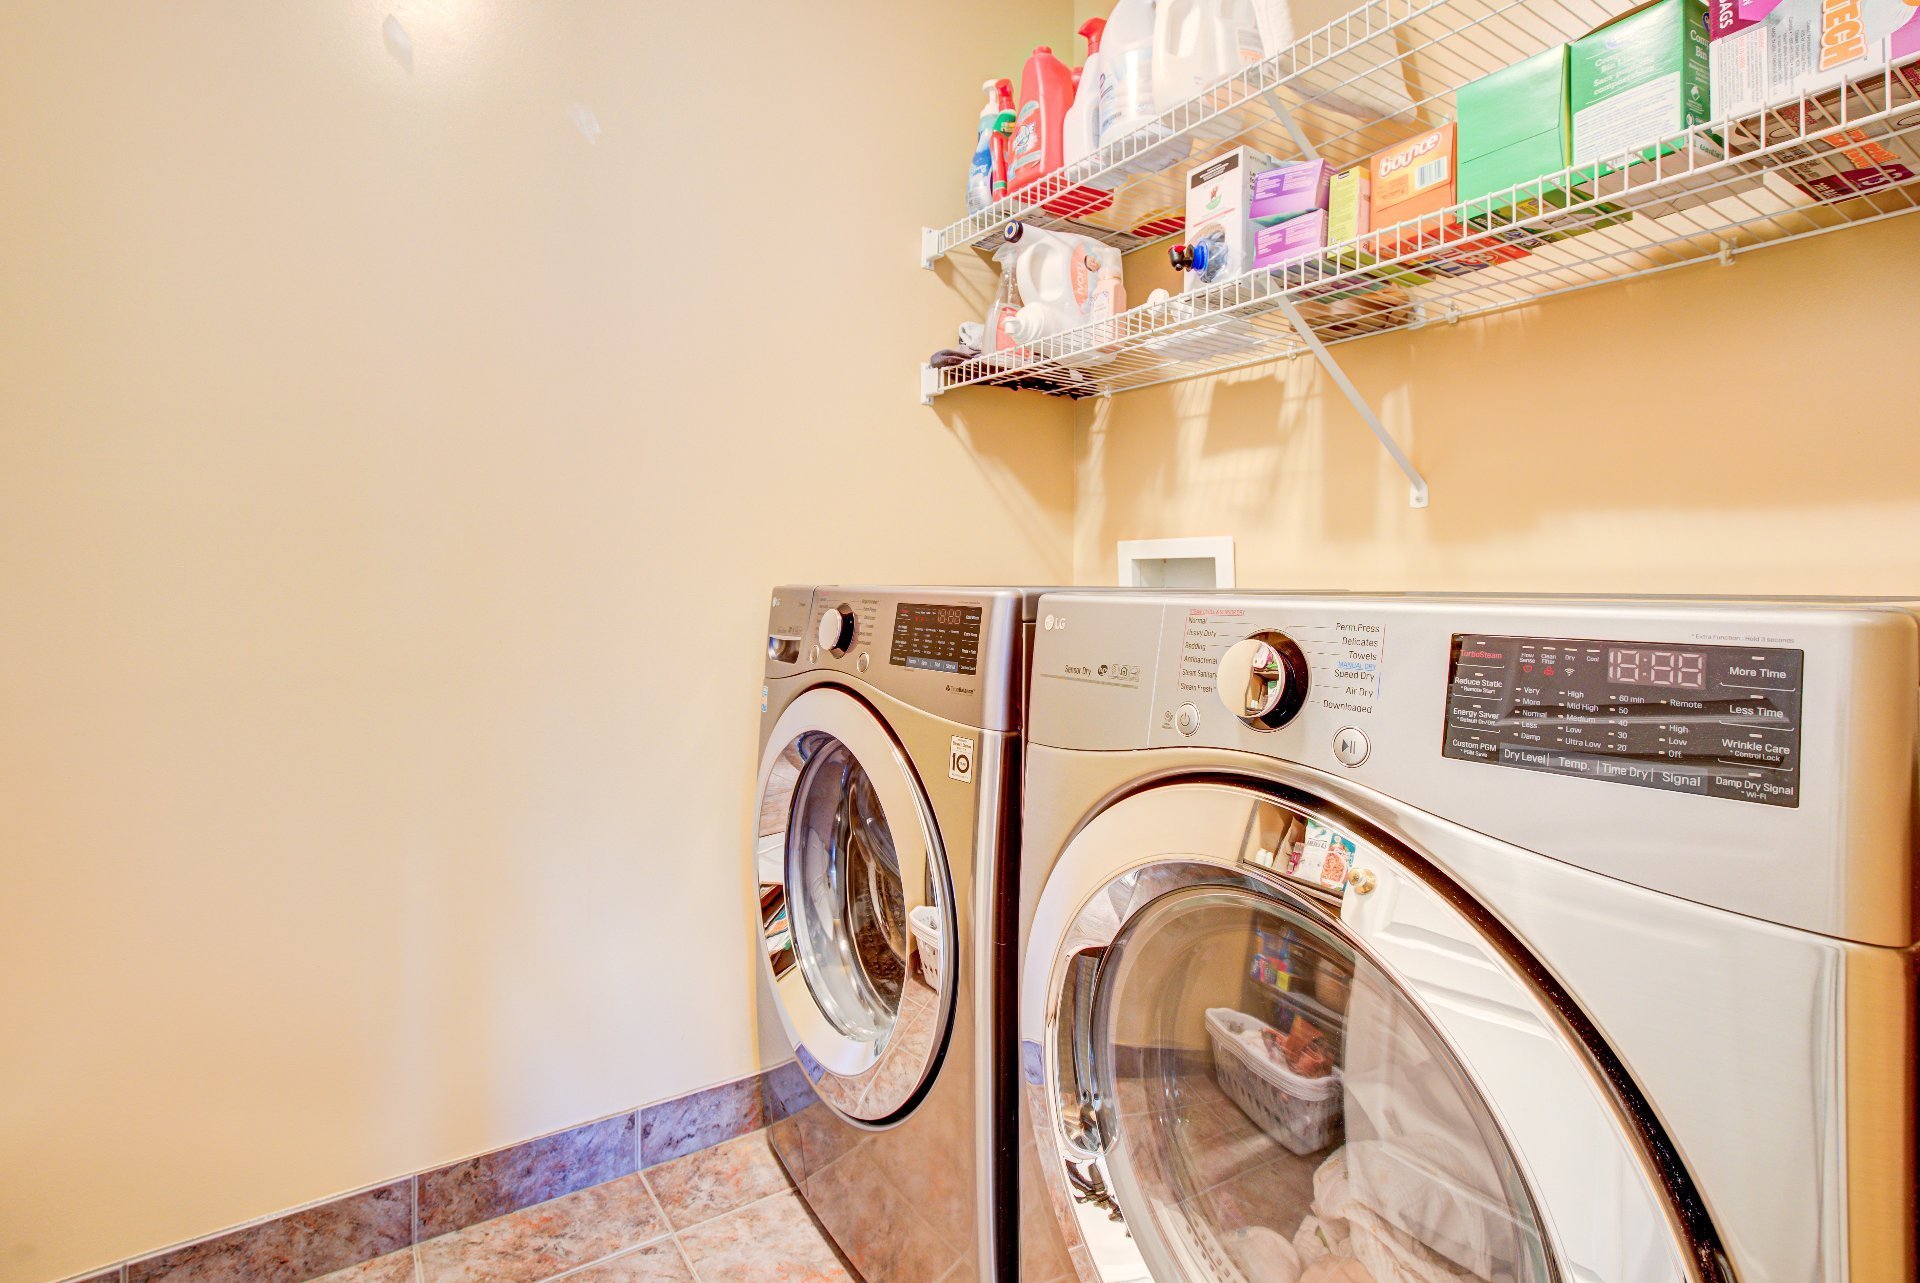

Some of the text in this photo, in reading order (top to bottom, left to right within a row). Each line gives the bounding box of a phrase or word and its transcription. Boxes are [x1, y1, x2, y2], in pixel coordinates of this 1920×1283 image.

[1719, 0, 1733, 29] AGS
[1342, 636, 1379, 647] Delicates
[1349, 650, 1377, 661] Towels
[1460, 649, 1503, 659] TurboSteam
[1334, 668, 1375, 682] Speed Dry
[1729, 666, 1787, 679] More Time
[1454, 676, 1503, 688] Reduce Static
[1345, 686, 1374, 698] Air Dry
[1524, 686, 1540, 695] Very
[1567, 690, 1584, 699] High
[1522, 698, 1541, 706] More
[1630, 696, 1645, 704] min
[1670, 699, 1703, 709] Remote
[1323, 699, 1373, 714] Downloaded
[1566, 702, 1599, 712] Mid High
[1618, 707, 1629, 715] 50
[1729, 704, 1784, 718] Less Time
[1453, 708, 1500, 719] Energy Saver
[1522, 710, 1548, 718] Normal
[1566, 713, 1596, 724] Medium
[1617, 719, 1628, 727] 40
[1565, 726, 1583, 734] Low
[1617, 731, 1628, 739] 30
[1669, 725, 1689, 734] High
[1521, 732, 1541, 742] Damp
[1668, 737, 1688, 746] Low
[1452, 738, 1497, 752] Custom PGM
[1565, 738, 1601, 749] Ultra Low
[1616, 744, 1627, 752] 20
[1721, 738, 1790, 755] Wrinkle Care
[1504, 748, 1546, 764] Dry Level
[1668, 750, 1682, 758] Off
[1734, 750, 1781, 762] Control Lock
[952, 752, 970, 774] 10
[1558, 756, 1591, 772] Temp.
[1602, 763, 1649, 781] Time Dry
[1662, 772, 1701, 787] Signal
[1716, 776, 1794, 796] Damp Dry Signal
[1746, 791, 1767, 800] Wi-Fi
